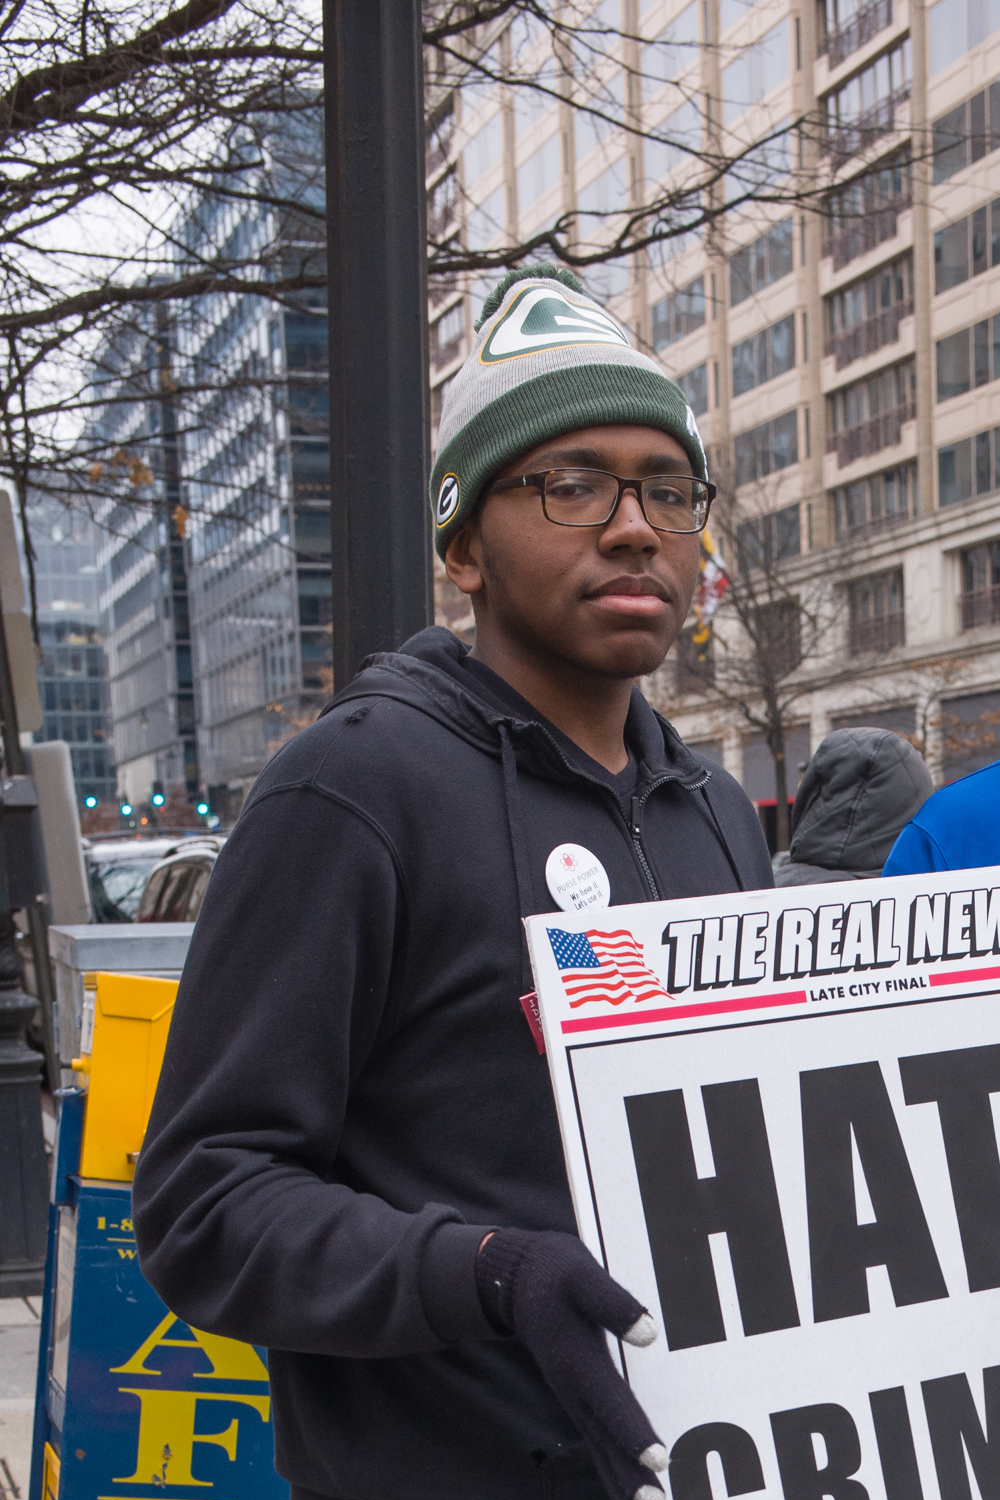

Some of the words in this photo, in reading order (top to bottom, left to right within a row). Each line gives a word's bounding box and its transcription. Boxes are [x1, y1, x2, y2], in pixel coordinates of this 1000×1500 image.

[577, 866, 600, 883] POWER
[661, 911, 769, 994] THE
[773, 899, 900, 982] REAL
[810, 986, 845, 1002] LATE
[848, 981, 881, 997] CITY
[885, 976, 927, 992] FINAL
